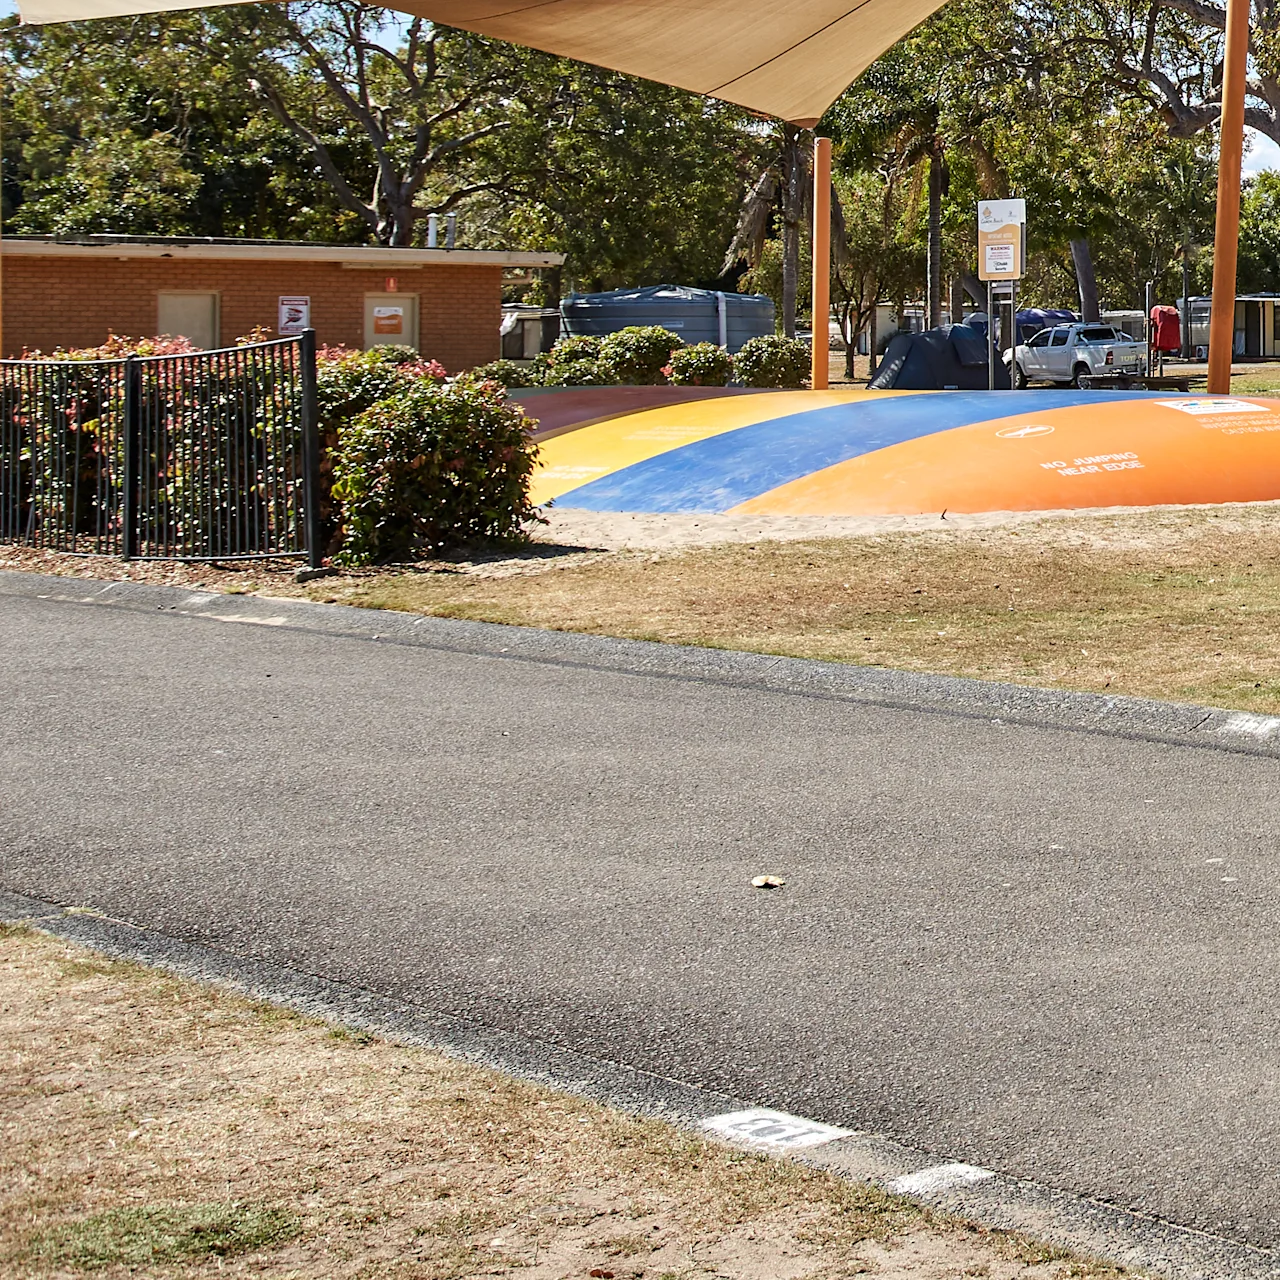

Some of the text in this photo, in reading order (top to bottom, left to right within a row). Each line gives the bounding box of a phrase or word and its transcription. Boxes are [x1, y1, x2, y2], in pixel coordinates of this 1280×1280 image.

[1120, 353, 1147, 361] TOYTA
[1040, 452, 1138, 470] NO JUMPING
[1057, 460, 1145, 476] NEAR EDGE
